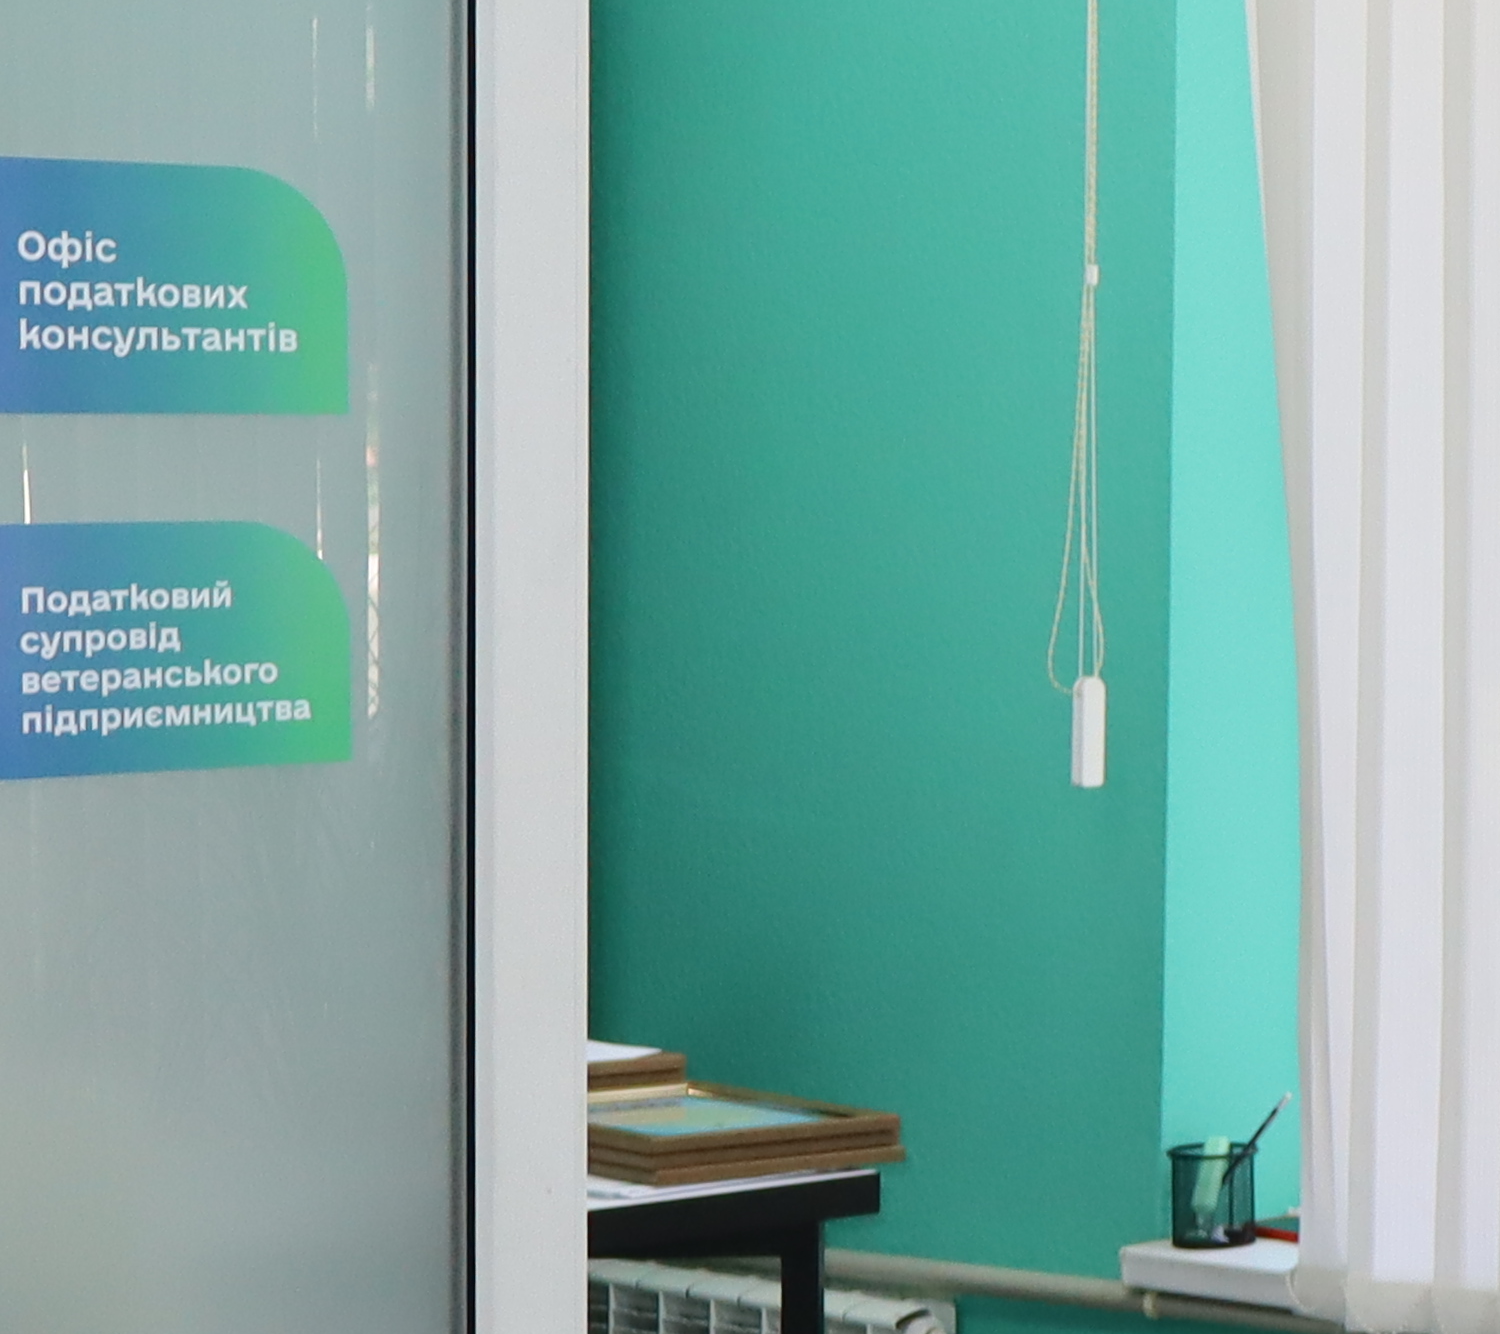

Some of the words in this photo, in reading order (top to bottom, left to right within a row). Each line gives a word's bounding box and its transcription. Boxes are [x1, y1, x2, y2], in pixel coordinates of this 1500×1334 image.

[17, 230, 117, 268] Офіс
[18, 276, 249, 311] податкових
[18, 317, 298, 358] консультантів
[21, 580, 232, 617] Податковий
[20, 621, 182, 660] супровід
[21, 659, 279, 697] ветеранського
[21, 698, 312, 736] підприємництва
